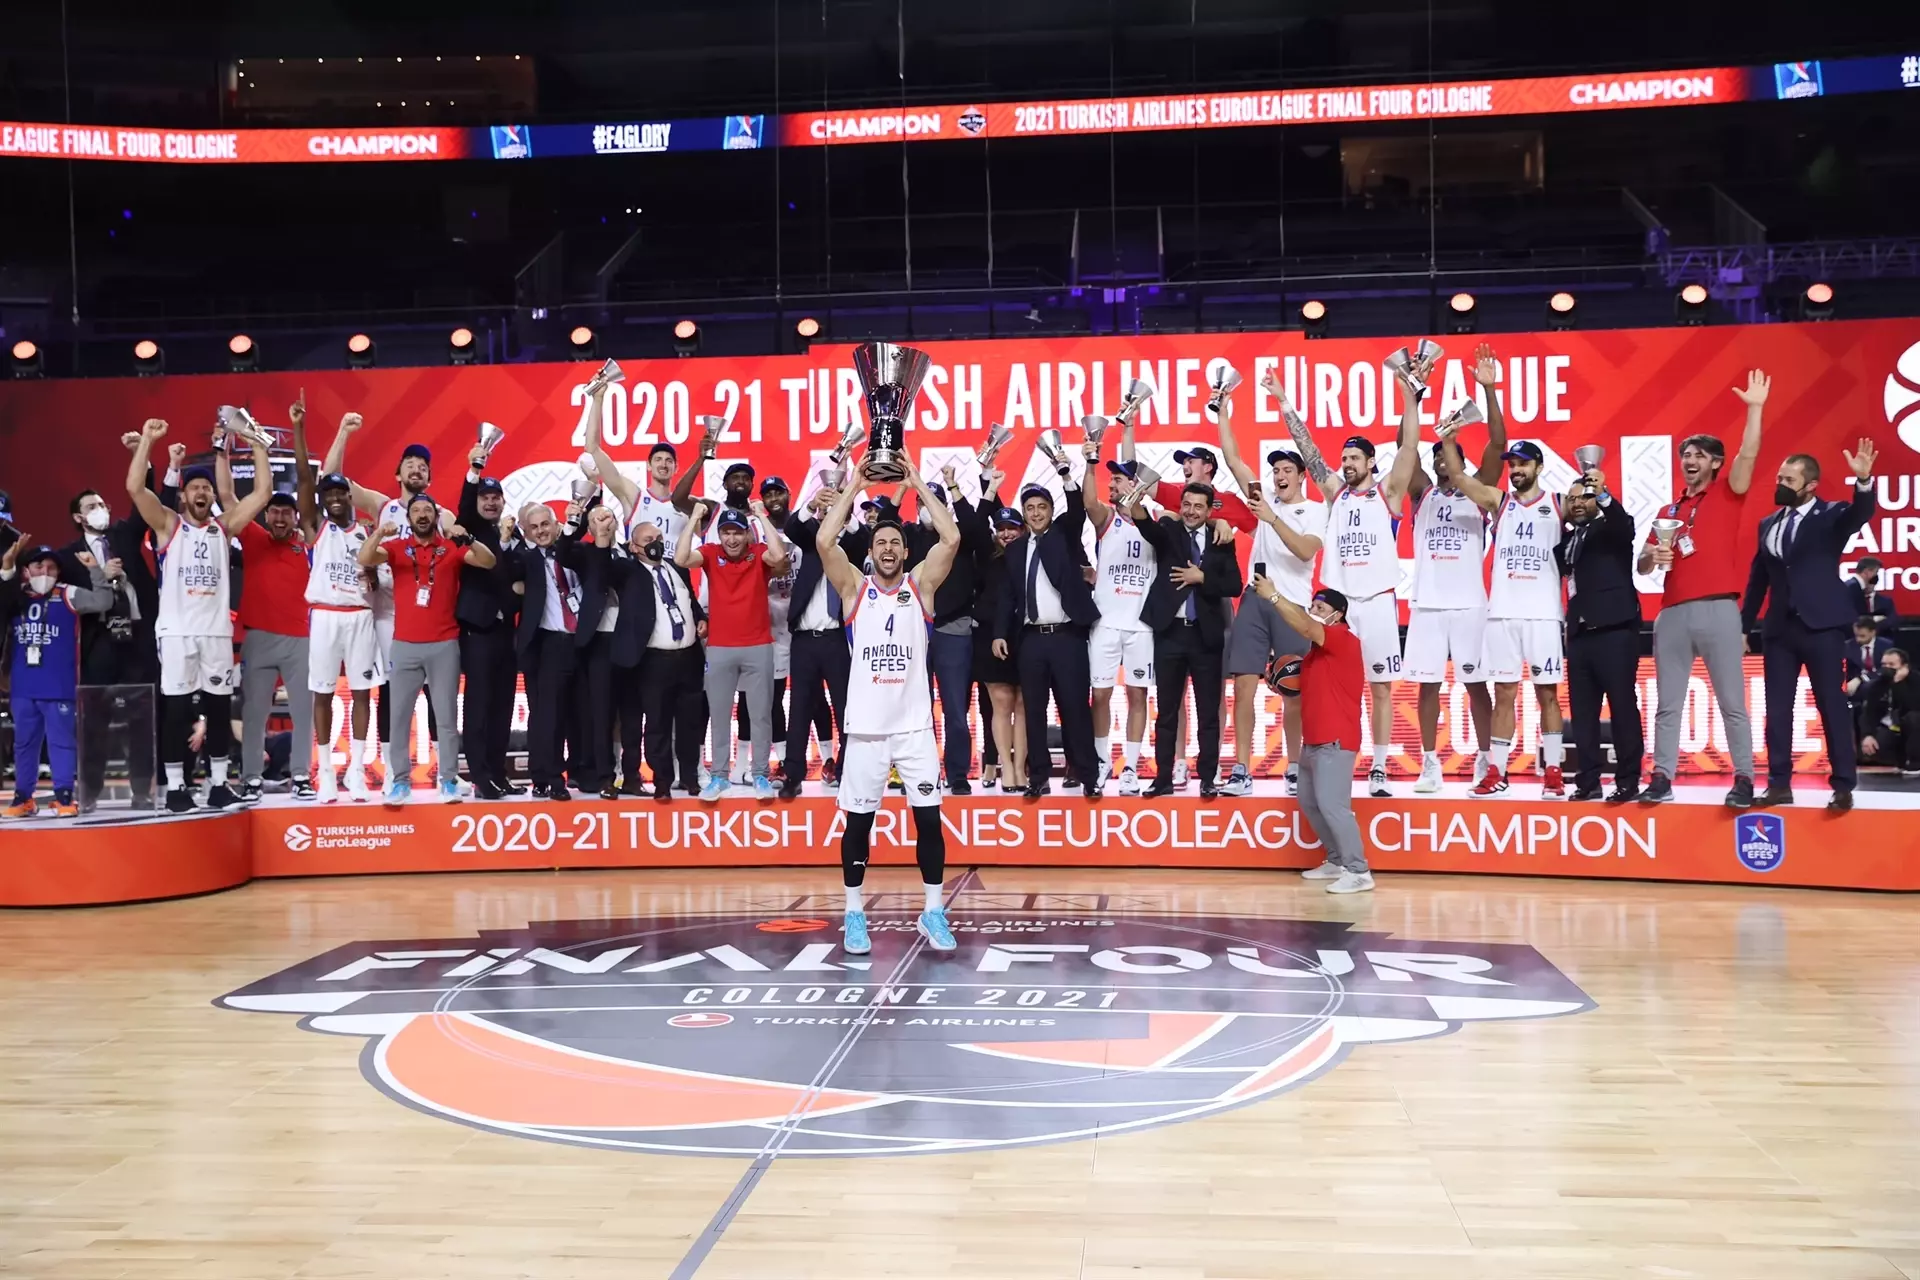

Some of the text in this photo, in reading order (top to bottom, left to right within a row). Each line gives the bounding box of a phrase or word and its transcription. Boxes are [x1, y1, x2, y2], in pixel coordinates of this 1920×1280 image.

[1569, 76, 1713, 105] CHAMPION
[1015, 85, 1492, 132] 2021 TURKISH AIRLINES EUROLEAGUE FINAL FOUR COLOGNE
[811, 113, 940, 138] CHAMPION
[0, 126, 237, 159] EAGUE FINAL FOUR COLOGNE
[308, 134, 438, 156] CHAMPION
[593, 123, 671, 151] #F4GLORY
[570, 378, 763, 446] 2020-21
[780, 364, 982, 441] TURSH
[1348, 508, 1360, 527] 18
[1437, 505, 1452, 522] 42
[1425, 526, 1468, 542] ANADOLU
[1515, 521, 1533, 540] 44
[194, 541, 208, 559] 22
[1127, 541, 1141, 558] 19
[1340, 545, 1370, 557] EFES
[1429, 539, 1462, 551] EFES
[1500, 545, 1549, 562] ANADOLU
[1108, 564, 1151, 579] ANADOLU
[1507, 558, 1541, 571] EFES
[185, 576, 217, 587] EFES
[1114, 575, 1145, 587] EFES
[28, 603, 41, 621] 0
[885, 614, 894, 637] 4
[863, 644, 912, 661] ANADOLU
[871, 659, 906, 671] EFES
[1386, 655, 1401, 673] 18
[316, 823, 414, 836] TURKISH AIRLINES
[451, 808, 1656, 858] 2020-21 TURKISH ARLNES EUROLEAGU CHAMPION
[316, 836, 391, 850] EuroLeague
[1748, 850, 1774, 859] EFES
[316, 943, 1516, 986] FINAL FOUR
[683, 986, 1119, 1008] COLOGNE 2021
[752, 1016, 1057, 1027] TURKISH AIRLINES
